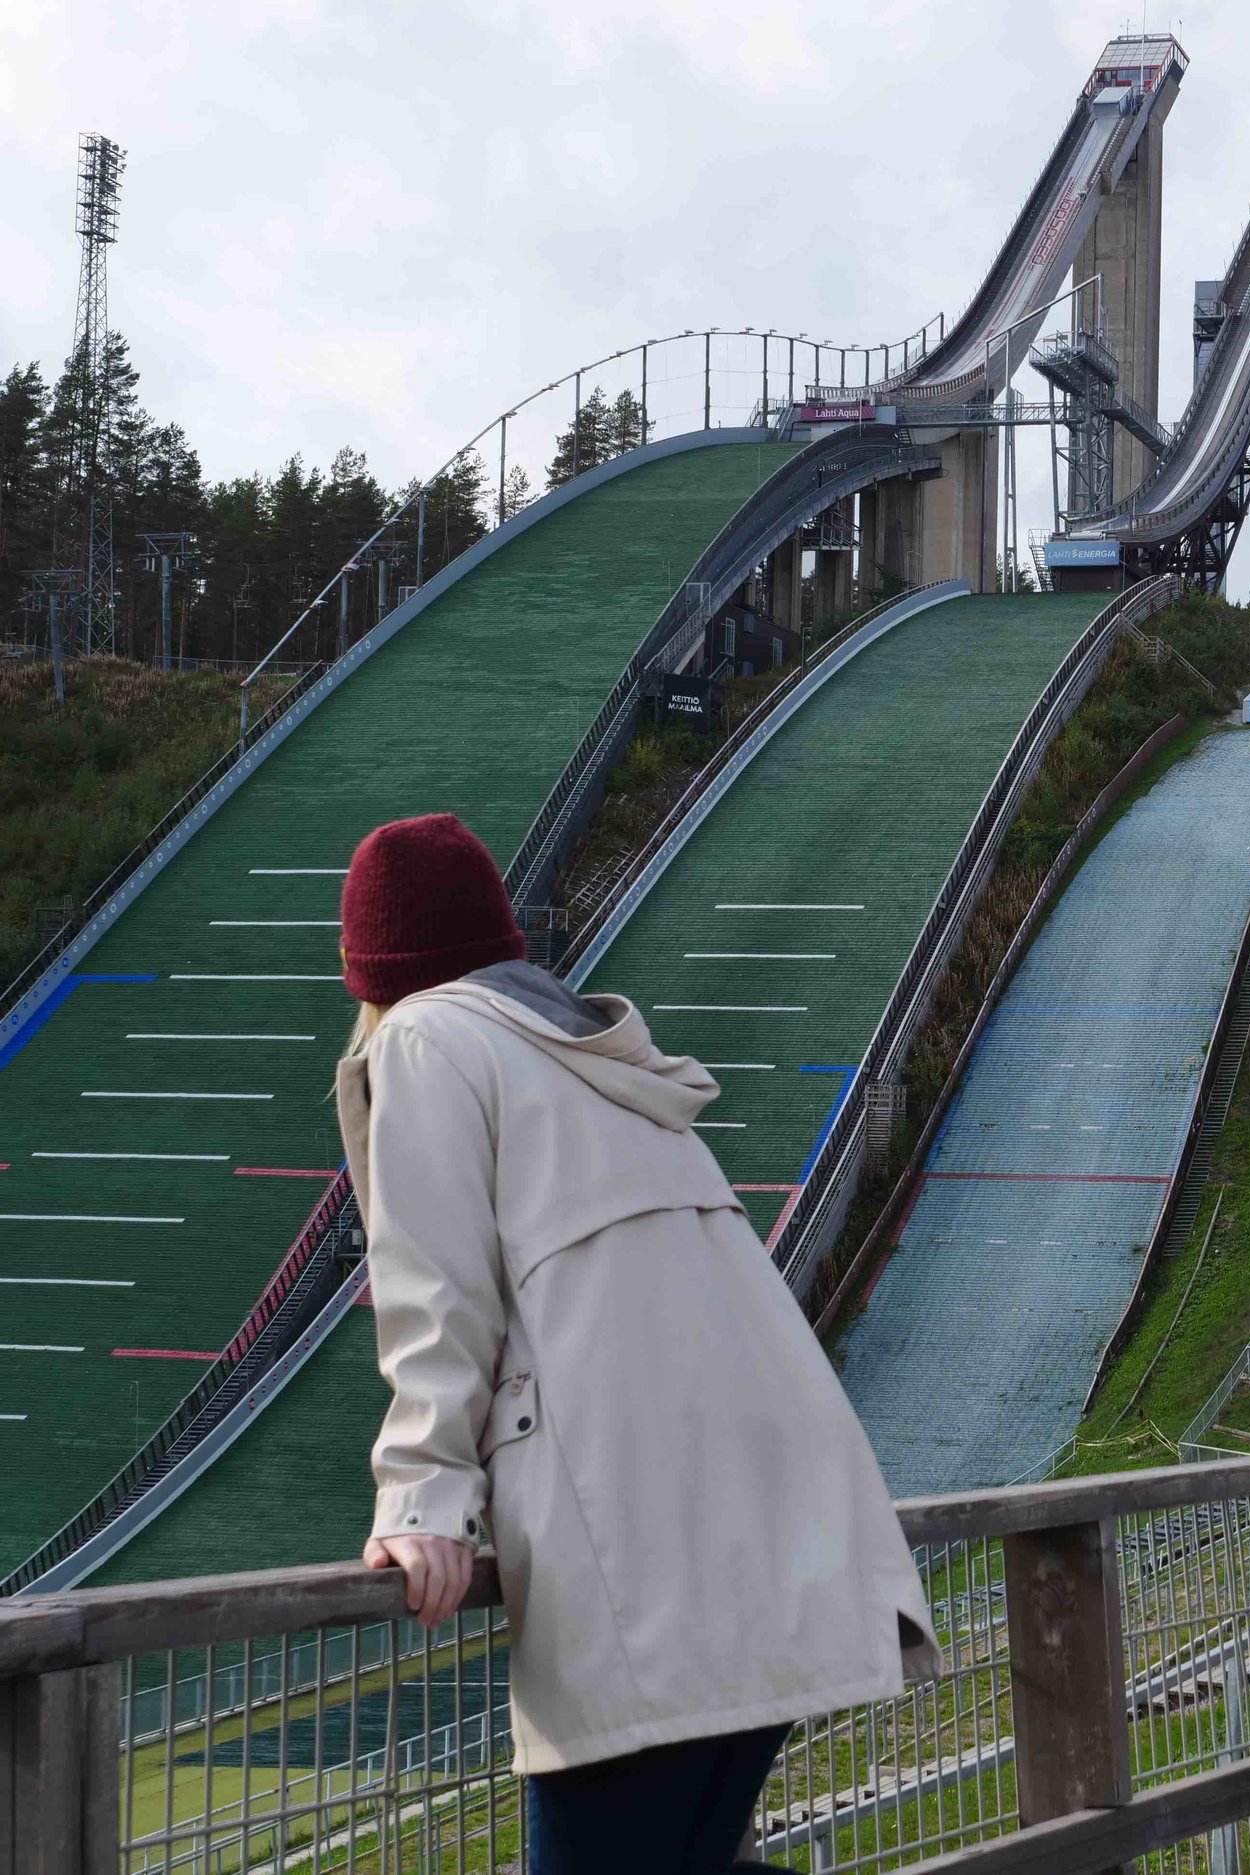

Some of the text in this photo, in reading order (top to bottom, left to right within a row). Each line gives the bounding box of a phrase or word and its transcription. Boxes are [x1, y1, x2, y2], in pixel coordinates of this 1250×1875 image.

[815, 409, 859, 419] Lahti Aqua
[1048, 549, 1116, 559] LAHTI ENERGIA
[671, 694, 700, 705] KEITTIÖ
